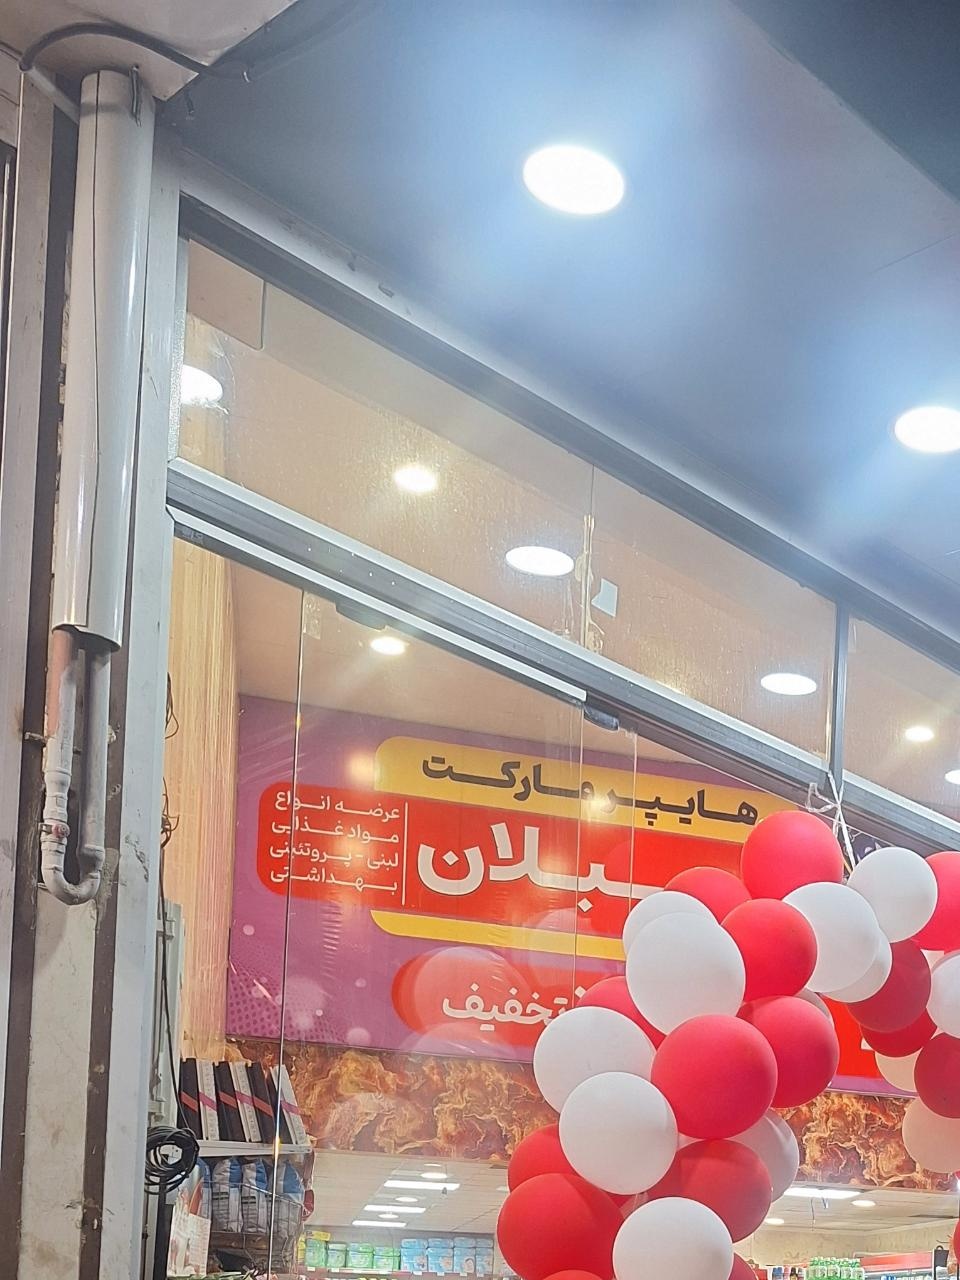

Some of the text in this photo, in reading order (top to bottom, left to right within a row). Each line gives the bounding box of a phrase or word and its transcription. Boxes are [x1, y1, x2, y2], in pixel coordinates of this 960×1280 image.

[275, 790, 400, 822] عرضه انواع
[271, 816, 399, 844] مواد غذایی
[269, 841, 352, 868] پروتئینی
[367, 852, 399, 871] لبنی
[270, 866, 398, 895] بهداشتی
